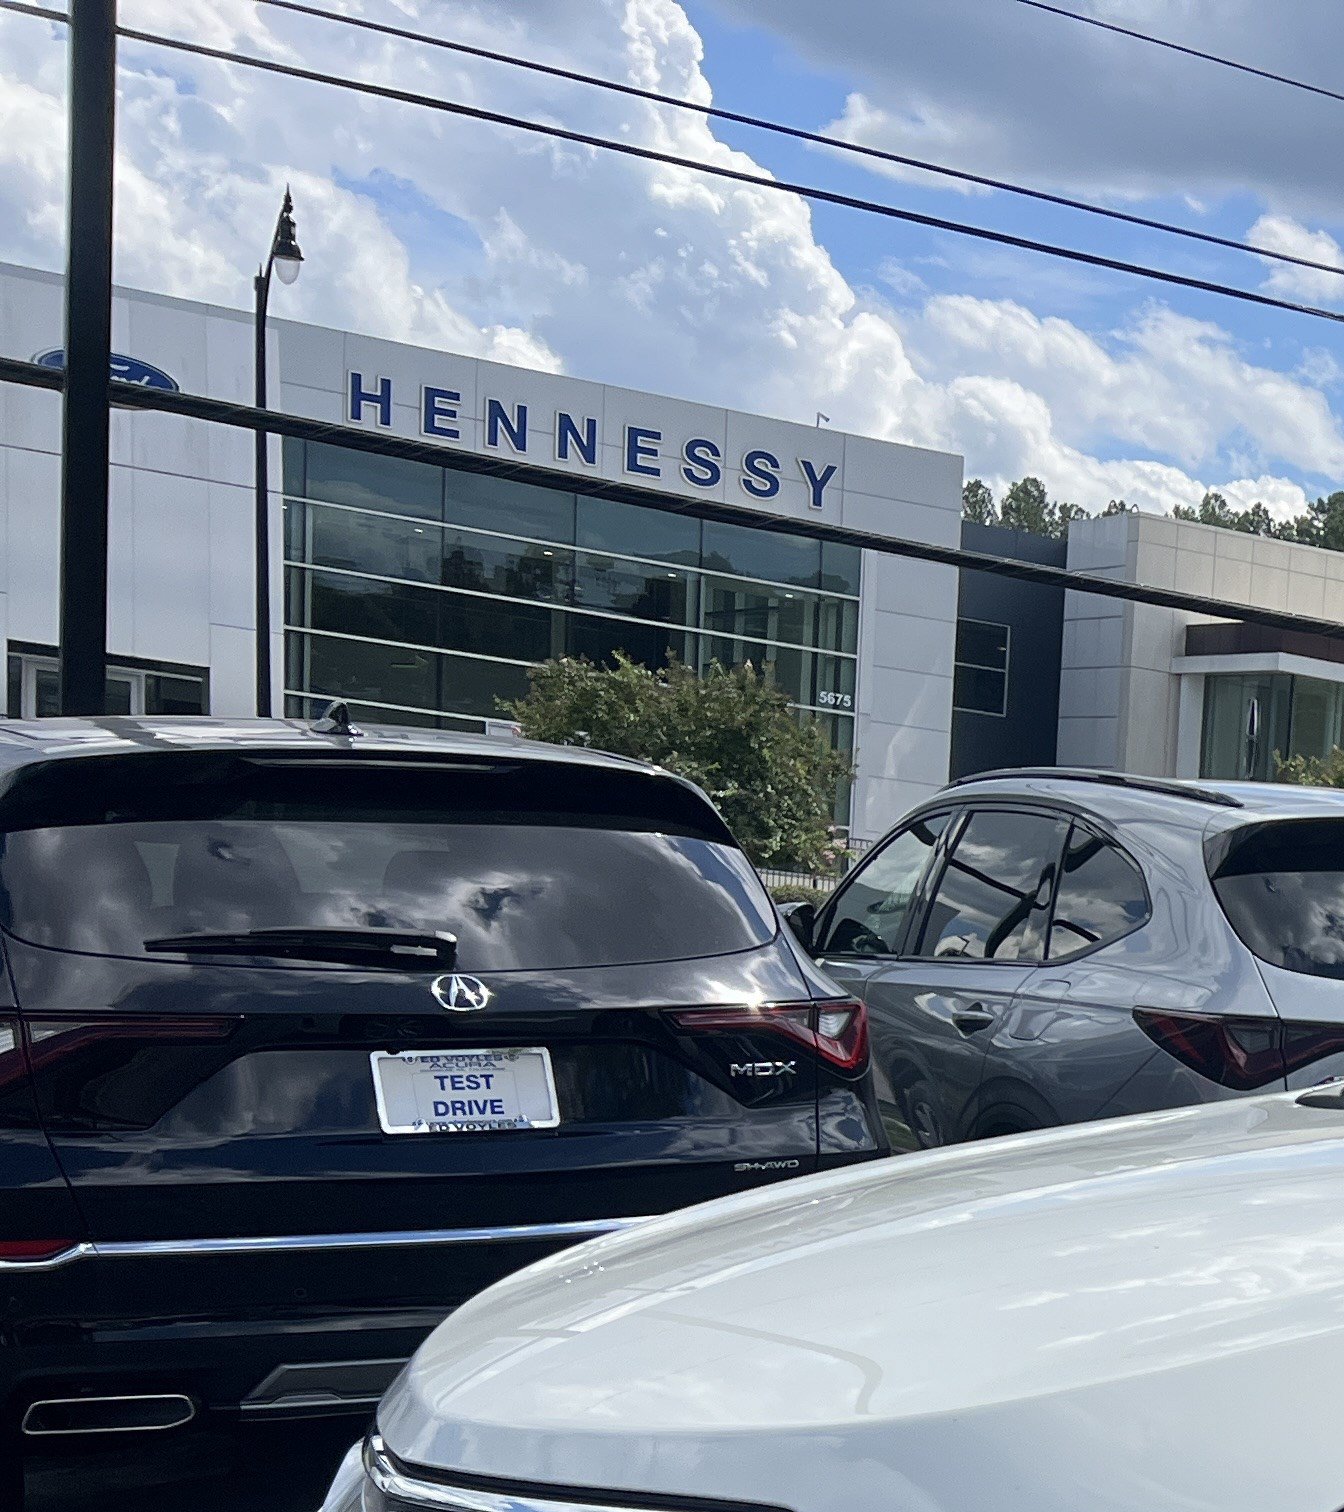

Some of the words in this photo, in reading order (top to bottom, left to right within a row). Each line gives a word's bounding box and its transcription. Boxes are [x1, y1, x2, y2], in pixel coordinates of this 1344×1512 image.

[348, 370, 838, 510] HENNESSY
[818, 691, 852, 708] 5675
[429, 1061, 497, 1071] ACURA
[729, 1060, 797, 1077] MDX
[434, 1073, 495, 1092] TEST
[433, 1098, 505, 1117] DRIVE
